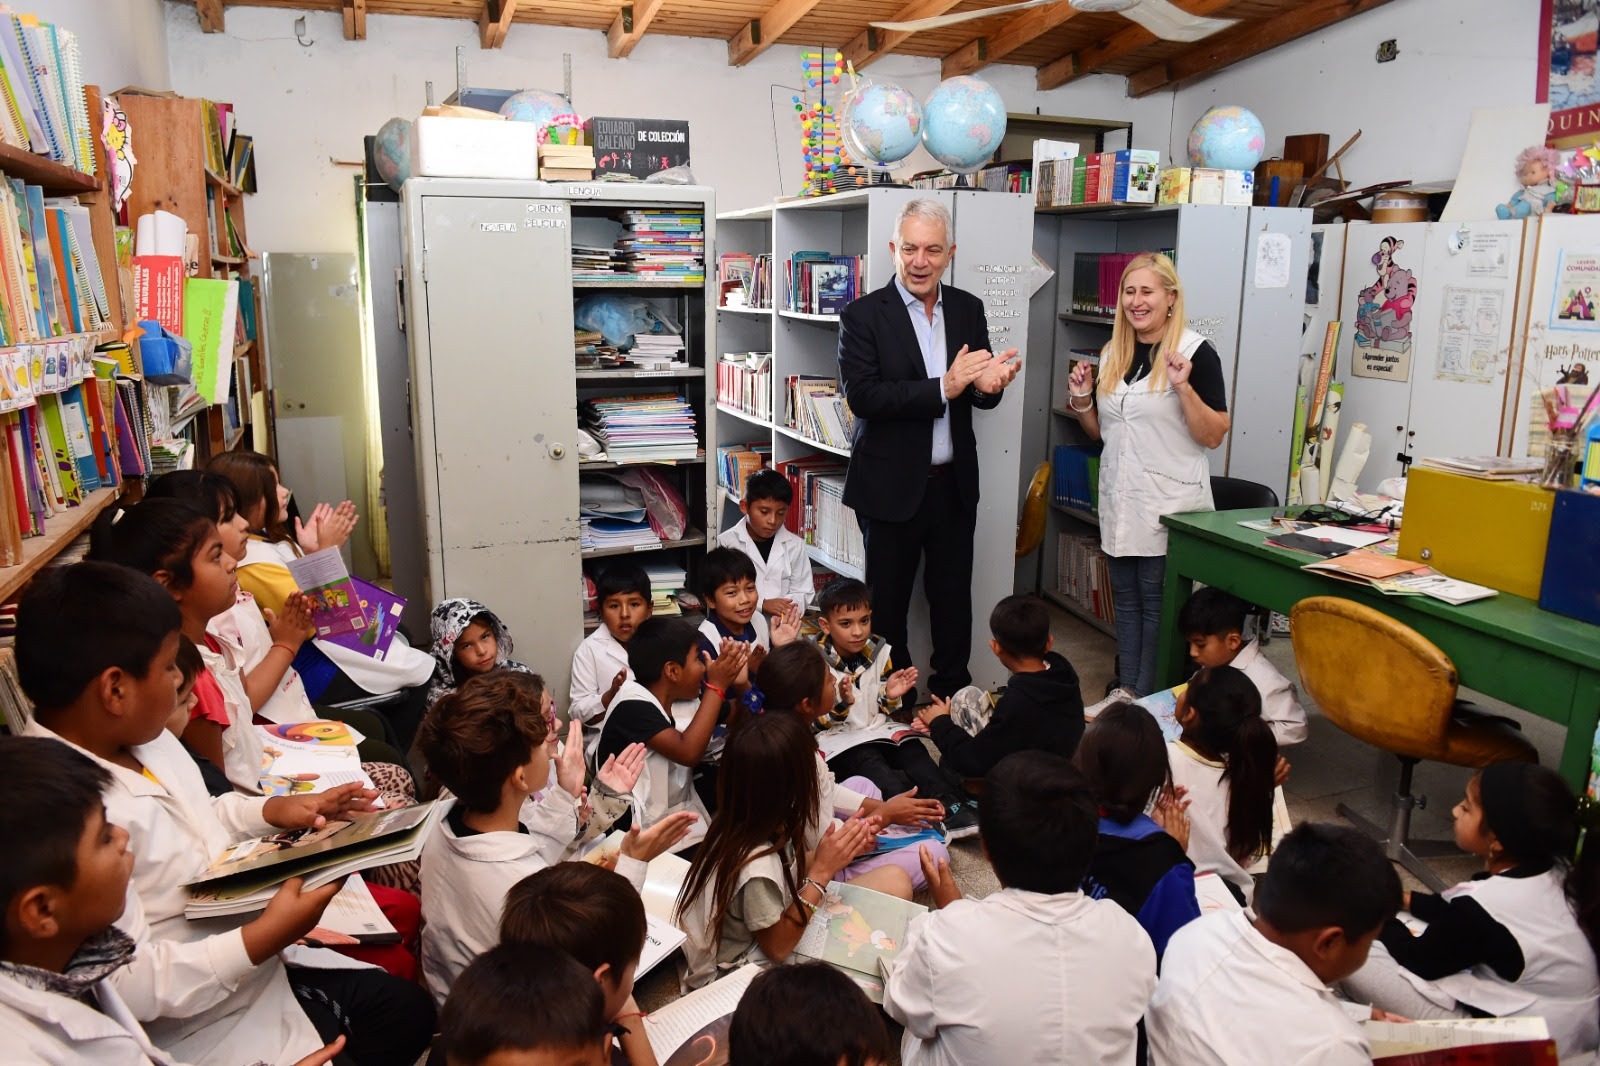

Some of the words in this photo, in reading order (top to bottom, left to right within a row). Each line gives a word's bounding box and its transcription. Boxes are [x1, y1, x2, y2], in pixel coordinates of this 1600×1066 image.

[598, 121, 635, 134] EDUARDO
[638, 131, 647, 141] DE
[648, 130, 685, 143] COLECCIÓN
[598, 135, 636, 150] GALEANO
[568, 187, 600, 196] LENGUA
[527, 204, 563, 213] CUENTO
[480, 223, 516, 231] NOVELA
[526, 219, 566, 228] PELICULA
